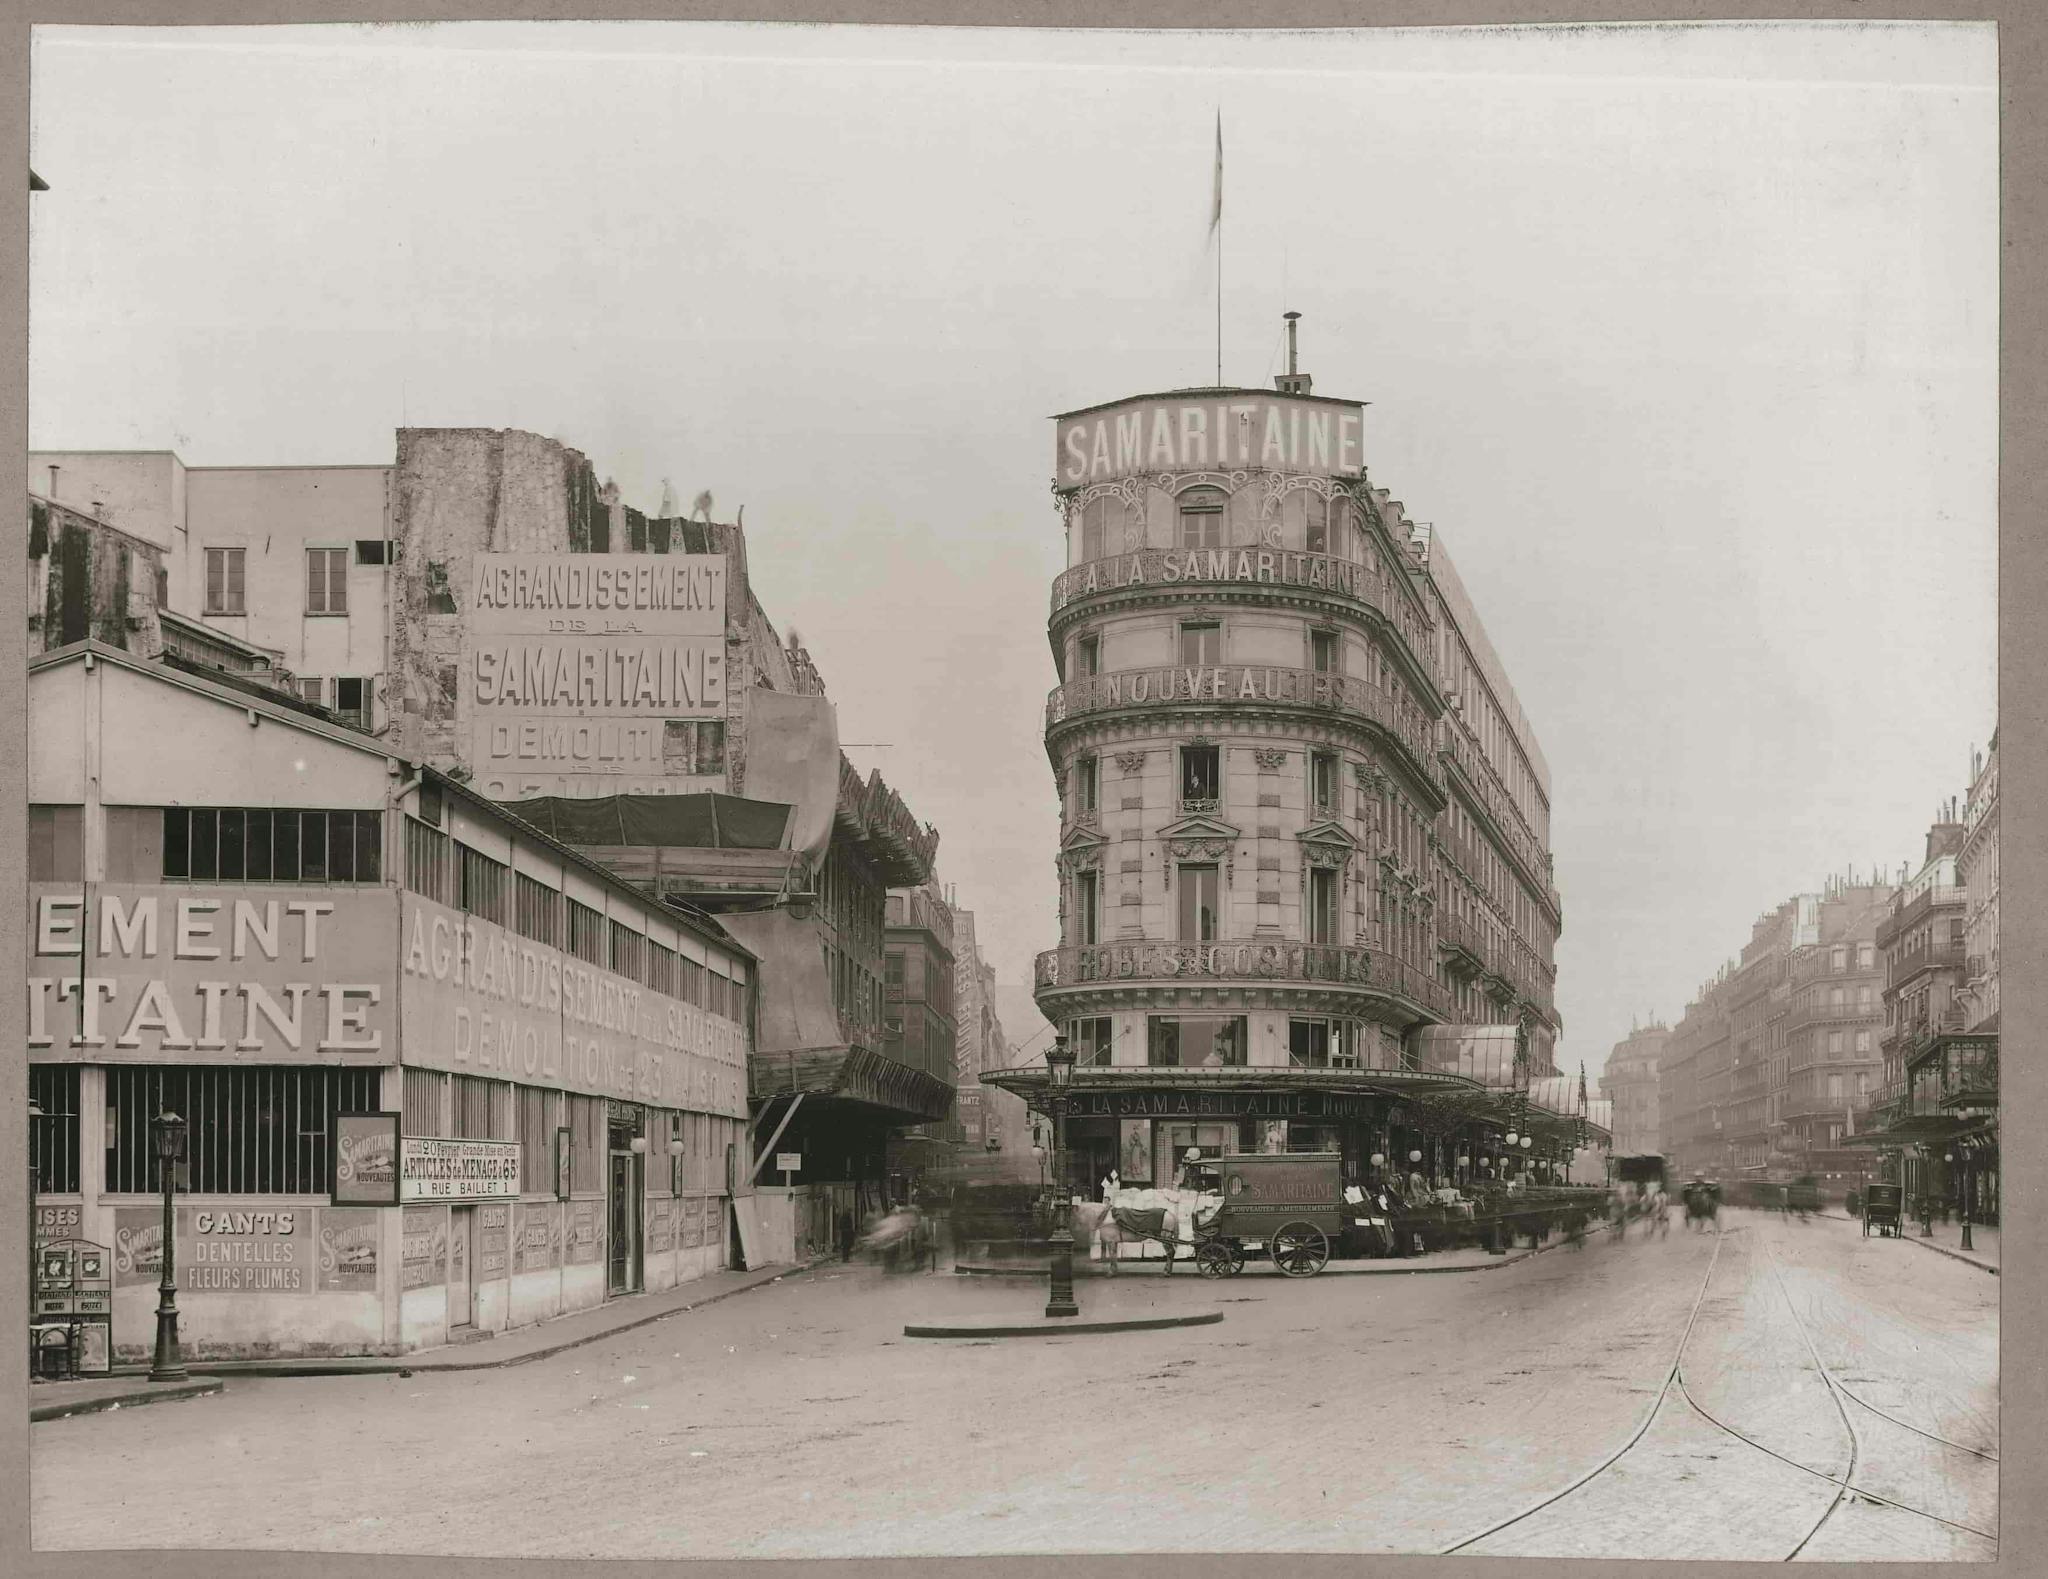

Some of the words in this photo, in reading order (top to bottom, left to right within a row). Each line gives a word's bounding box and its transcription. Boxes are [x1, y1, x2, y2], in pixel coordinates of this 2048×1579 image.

[1065, 405, 1360, 481] SAMARITAINE
[1085, 563, 1098, 594] A
[1115, 558, 1145, 587] LA
[1163, 550, 1361, 599] SAMARITAINE
[477, 564, 720, 610] AGRANDISSEMENT
[549, 619, 586, 632] DE
[603, 619, 642, 632] LA
[476, 647, 722, 708] SAMARITAINE
[34, 895, 334, 963] EMENT
[406, 909, 640, 1039] AGRANDISSEMENT
[28, 978, 382, 1053] ITAINE
[1092, 1095, 1112, 1113] LA
[1120, 1094, 1308, 1115] SAMARITAINE
[423, 1141, 436, 1155] 20
[403, 1157, 452, 1180] ARTICLES
[452, 1159, 461, 1179] de
[417, 1183, 423, 1194] 1
[432, 1182, 451, 1195] RUE
[460, 1181, 498, 1194] BAILLET
[504, 1182, 508, 1193] 1
[37, 1208, 79, 1226] ISES
[195, 1212, 295, 1235] GANTS
[196, 1242, 294, 1263] DENTELLES
[188, 1268, 241, 1289] FLEURS
[246, 1268, 301, 1290] PLUMES
